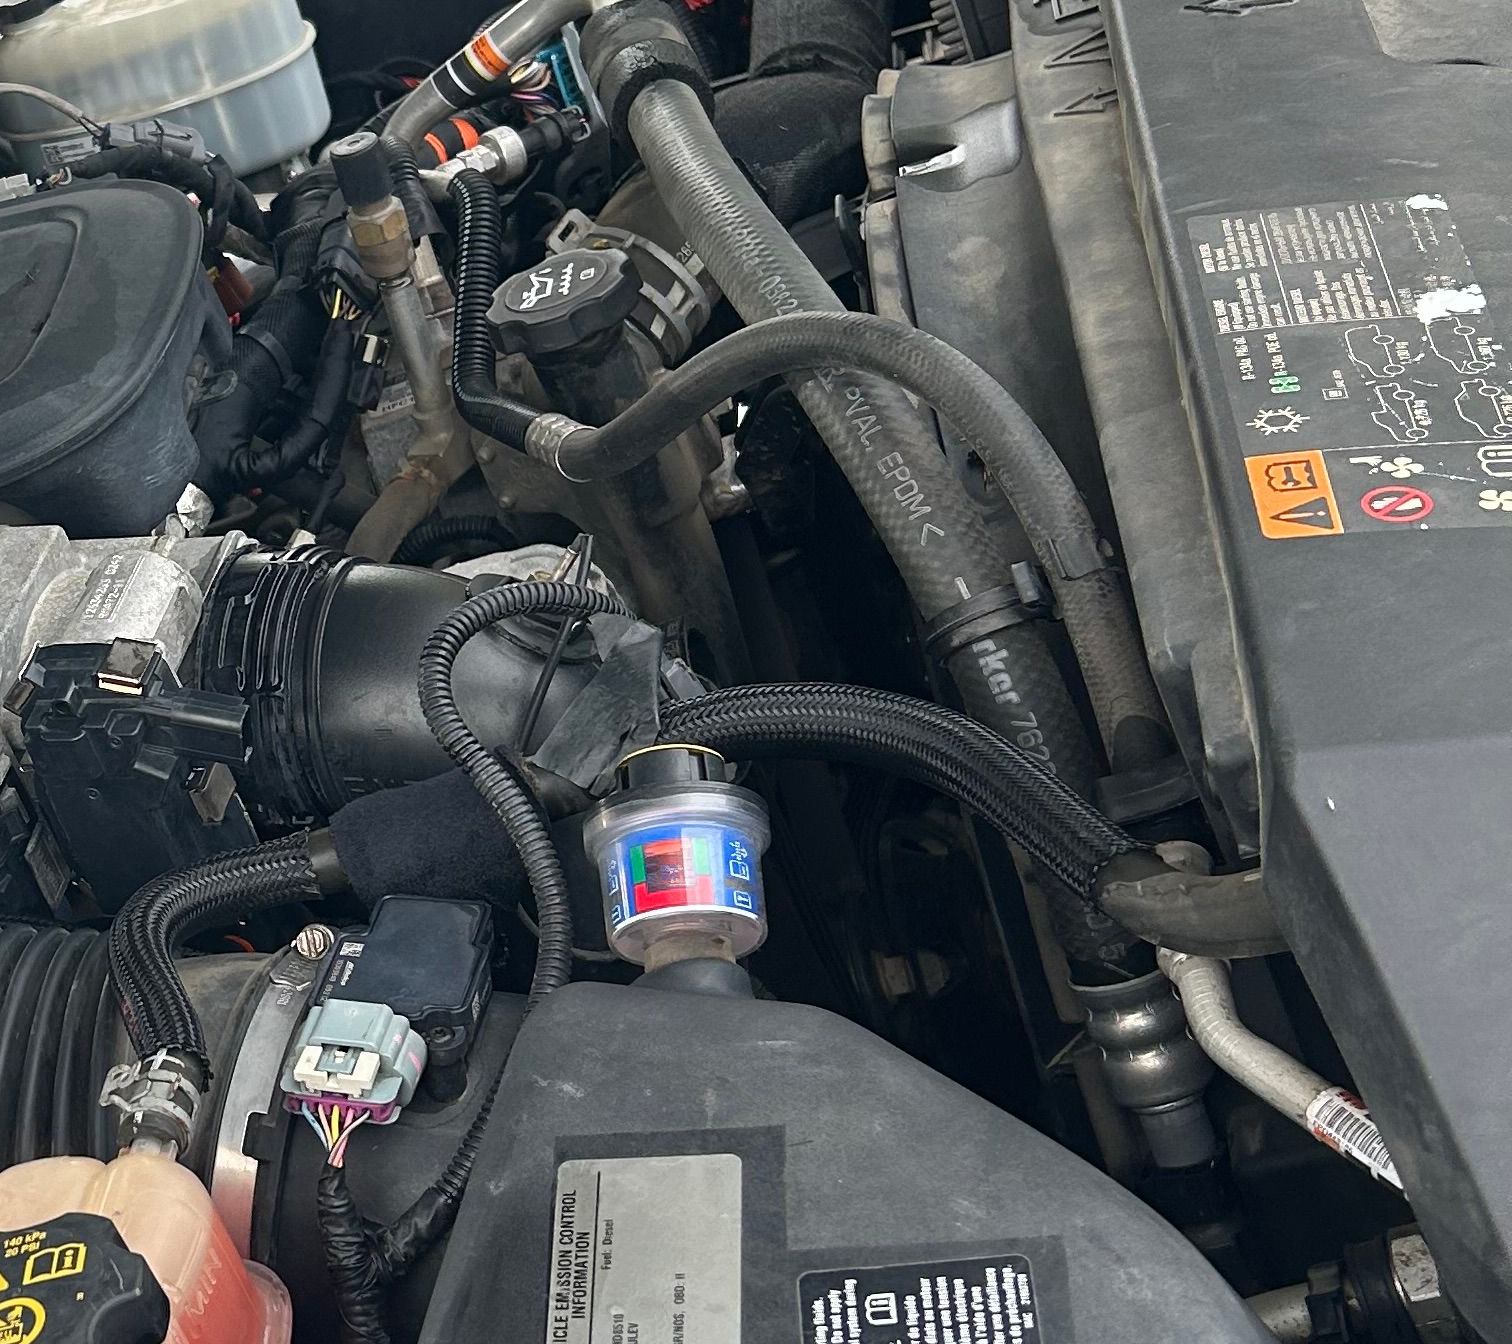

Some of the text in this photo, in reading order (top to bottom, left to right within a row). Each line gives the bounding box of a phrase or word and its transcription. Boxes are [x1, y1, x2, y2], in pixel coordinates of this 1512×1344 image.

[972, 639, 1021, 704] rker
[3, 1231, 47, 1249] 140 kPa
[558, 1189, 576, 1244] CONTROL
[571, 1231, 590, 1318] INFORMATION
[627, 1322, 638, 1344] ULEV
